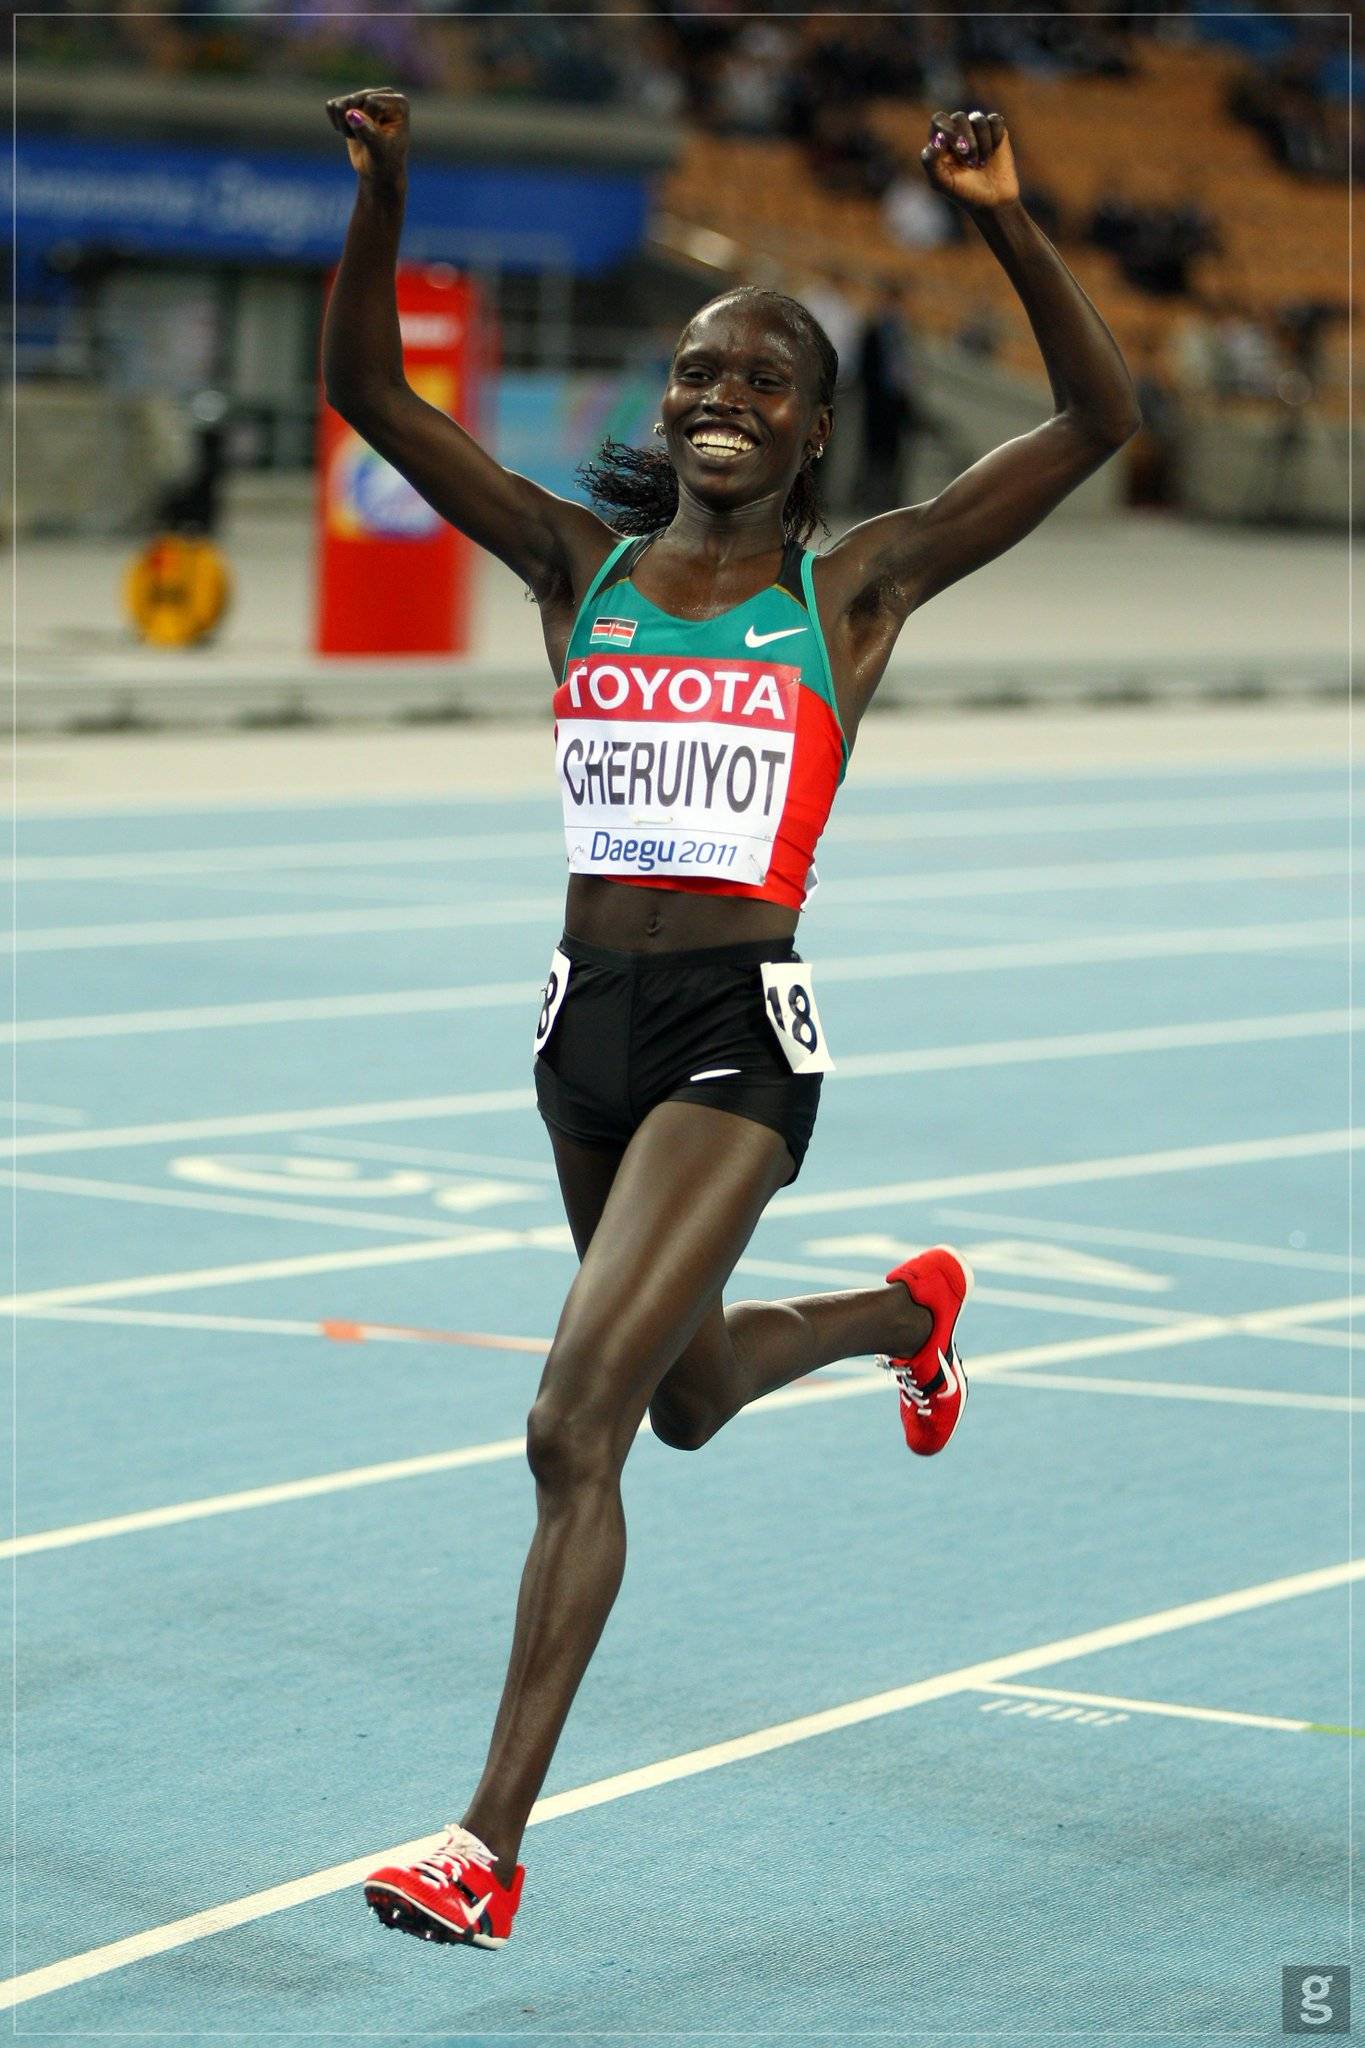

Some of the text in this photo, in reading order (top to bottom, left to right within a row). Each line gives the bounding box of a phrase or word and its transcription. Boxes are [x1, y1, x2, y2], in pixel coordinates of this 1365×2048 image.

[568, 665, 786, 721] TOYOTA
[563, 737, 787, 817] CHERUIYOT
[590, 831, 738, 872] Daegu 2011
[766, 983, 818, 1055] 18
